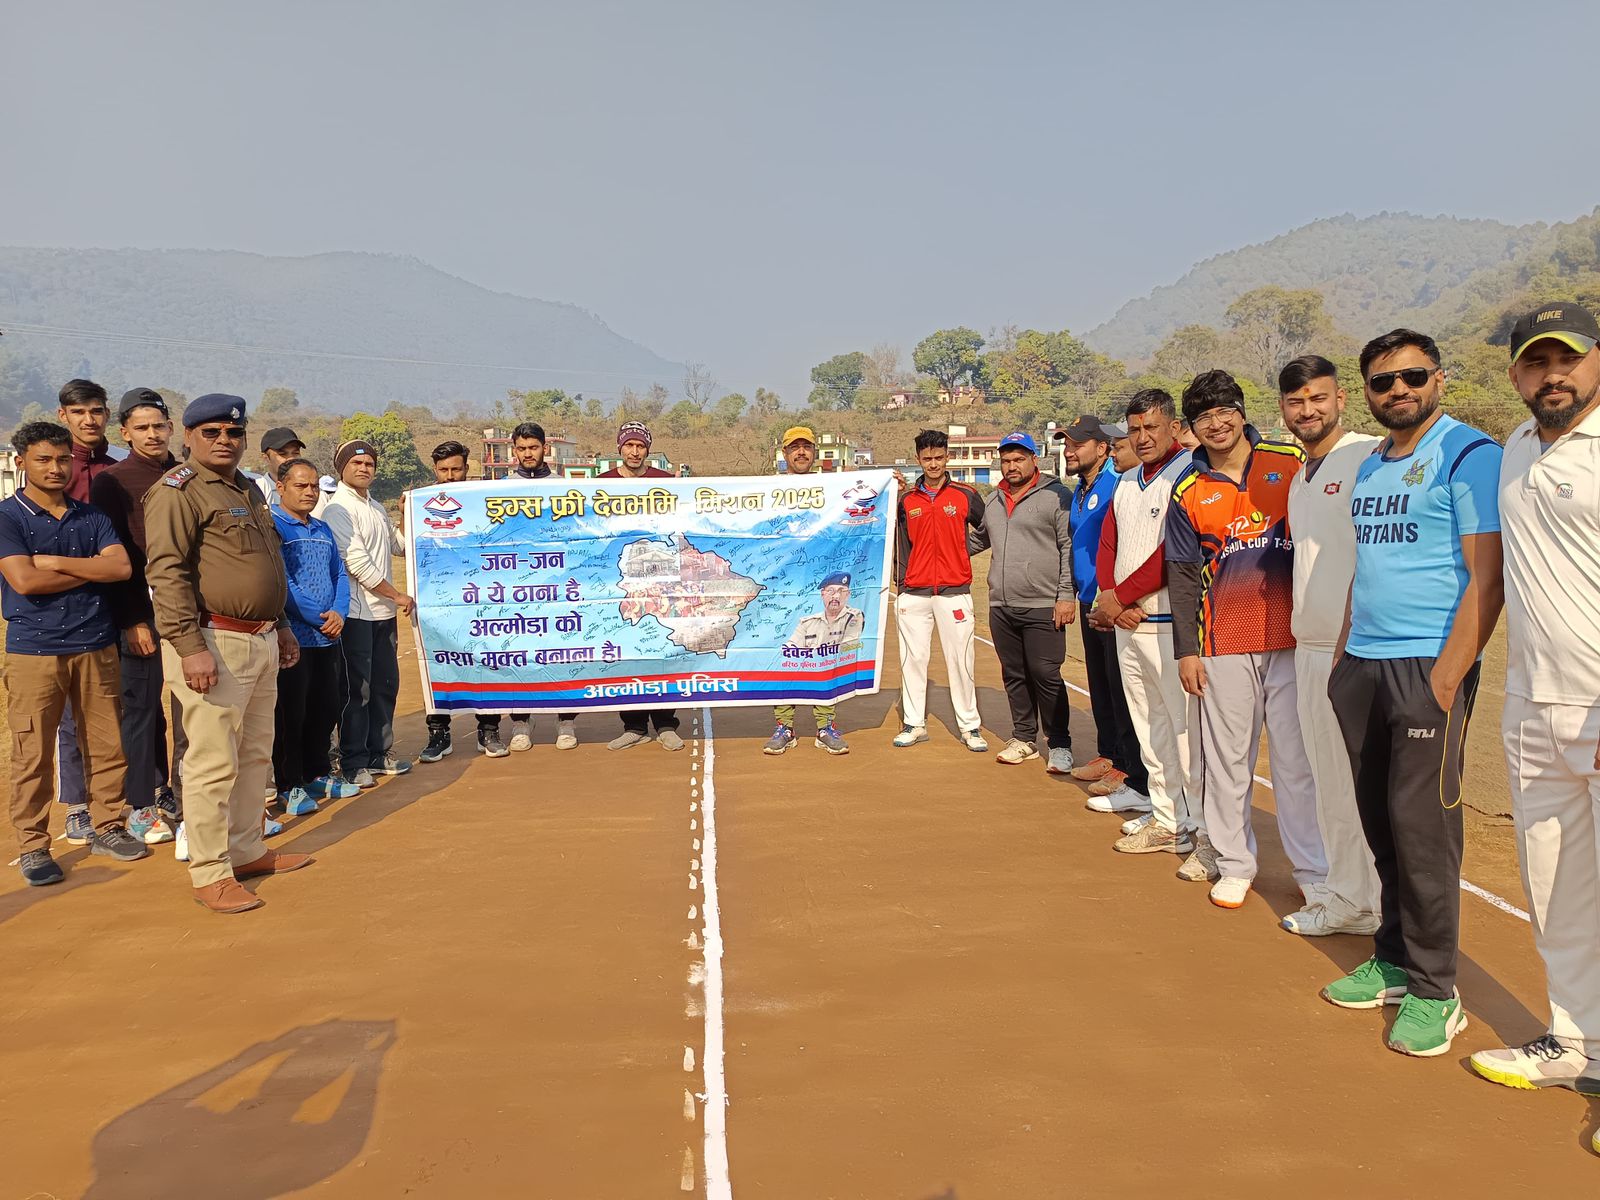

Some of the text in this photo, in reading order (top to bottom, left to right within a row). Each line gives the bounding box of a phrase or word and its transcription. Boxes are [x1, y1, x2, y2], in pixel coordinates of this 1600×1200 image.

[1536, 310, 1563, 323] NIKE
[486, 495, 543, 523] ड्रग्स
[550, 489, 586, 521] फ्री
[695, 487, 765, 514] मिशन
[772, 487, 825, 510] 2025
[1352, 494, 1410, 517] DELHI
[1247, 537, 1268, 549] CUP
[1354, 522, 1419, 544] ARTANS
[481, 551, 566, 571] जन-जन
[462, 582, 480, 604] ने
[487, 581, 506, 603] ये
[513, 584, 559, 603] ठाना
[555, 610, 583, 632] को
[433, 649, 473, 667] नशा
[480, 649, 528, 670] मुक्त
[535, 646, 595, 665] बनाना
[675, 673, 740, 697] पुलिस
